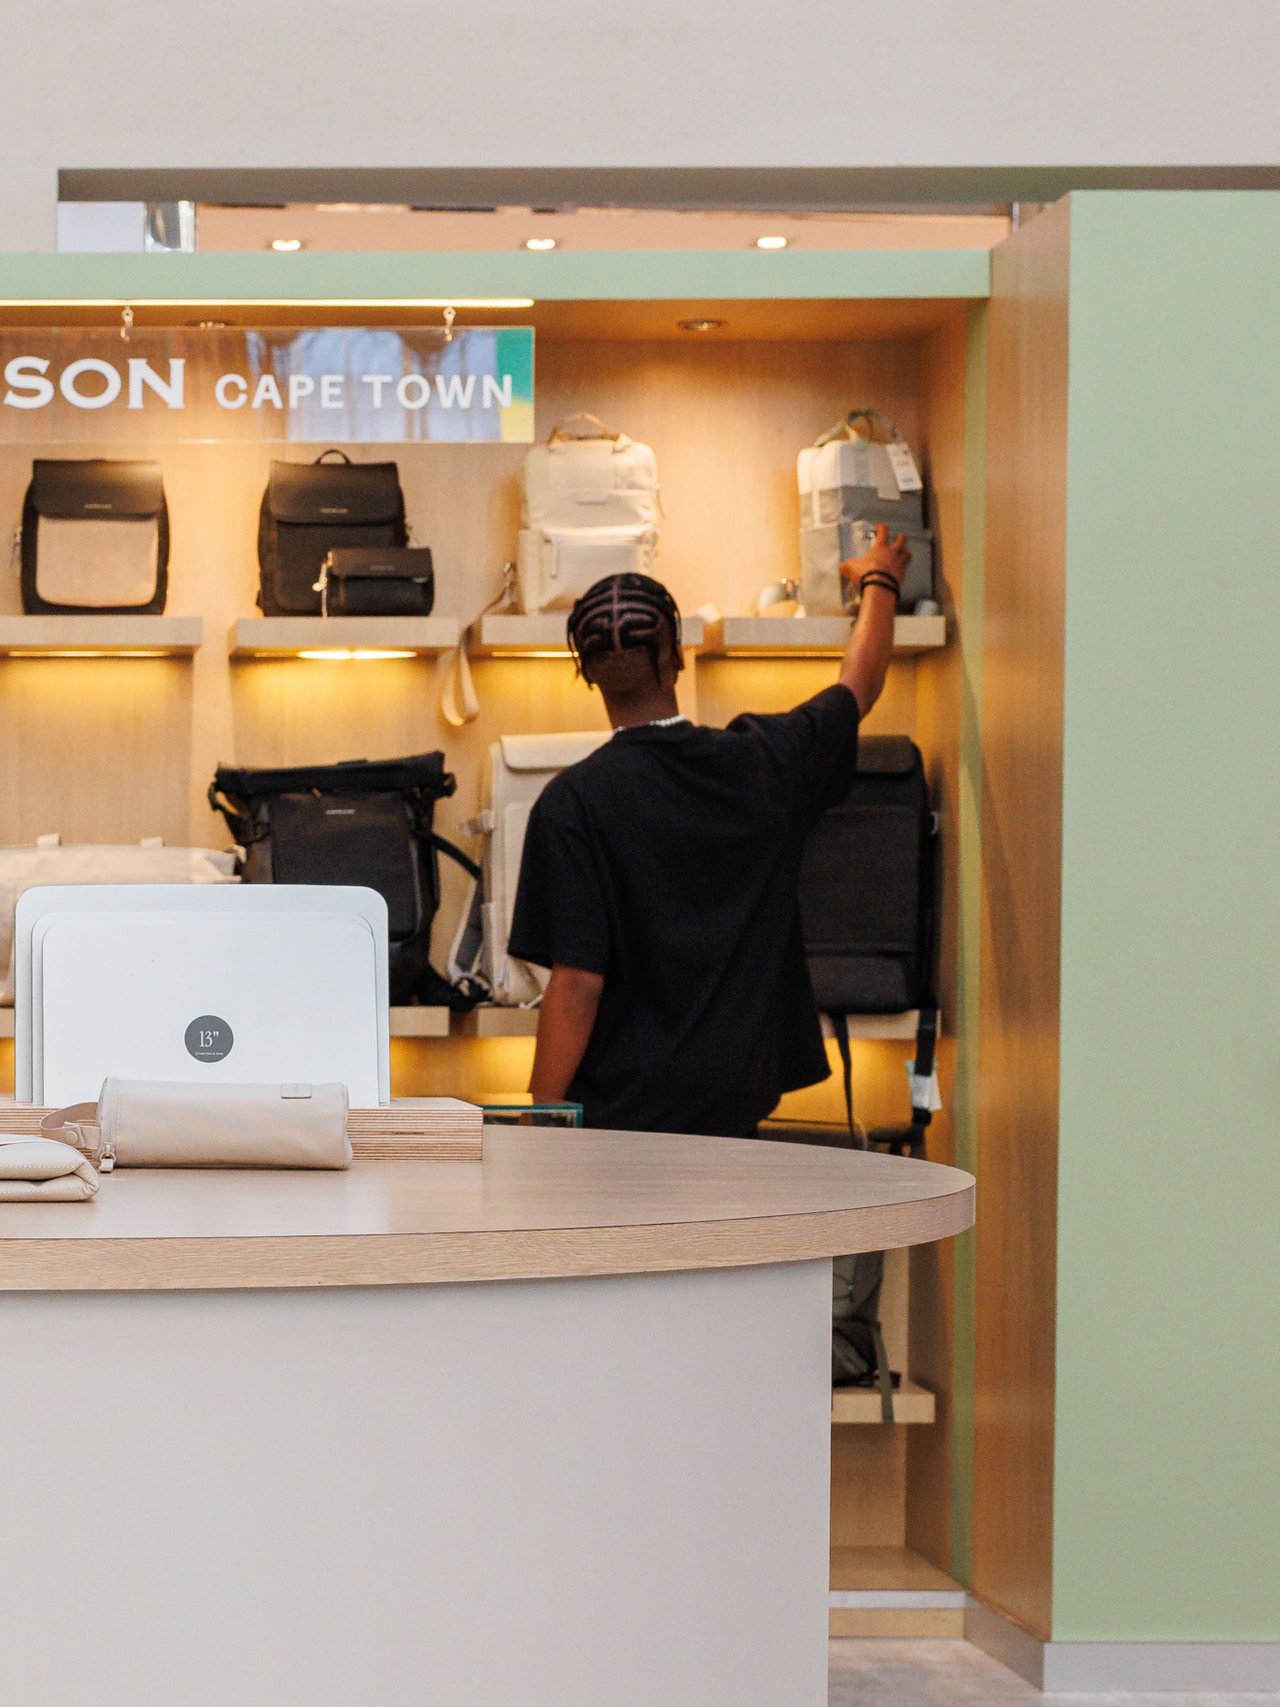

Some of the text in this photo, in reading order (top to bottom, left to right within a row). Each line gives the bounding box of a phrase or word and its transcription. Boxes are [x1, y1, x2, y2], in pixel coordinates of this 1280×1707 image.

[3, 355, 186, 410] SON
[214, 373, 345, 410] CAPE
[361, 374, 513, 410] TOWN
[199, 1030, 220, 1048] 13"
